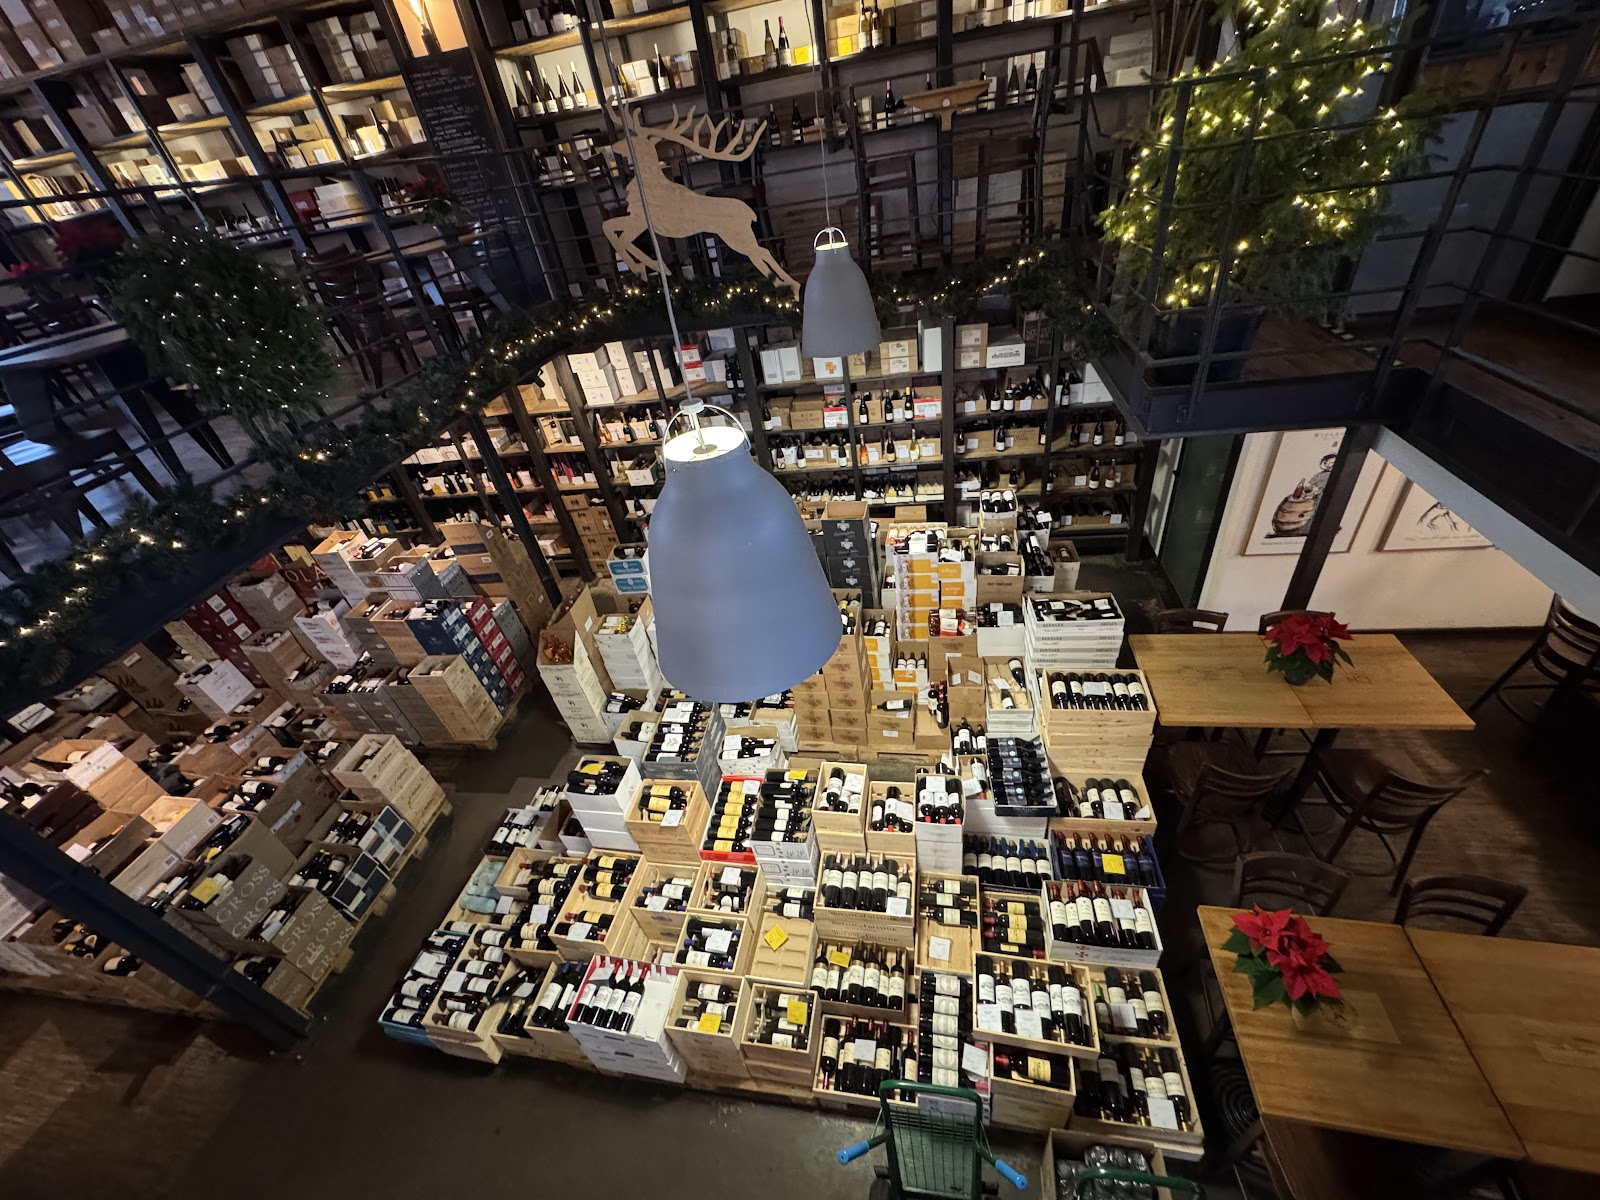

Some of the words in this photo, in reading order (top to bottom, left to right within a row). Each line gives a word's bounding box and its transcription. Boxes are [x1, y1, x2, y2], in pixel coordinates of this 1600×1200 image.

[216, 864, 271, 924] GROSS
[232, 879, 283, 938] GROSS
[281, 896, 329, 953] GROSS
[296, 911, 343, 968] GROSS
[311, 925, 355, 981] GROSS
